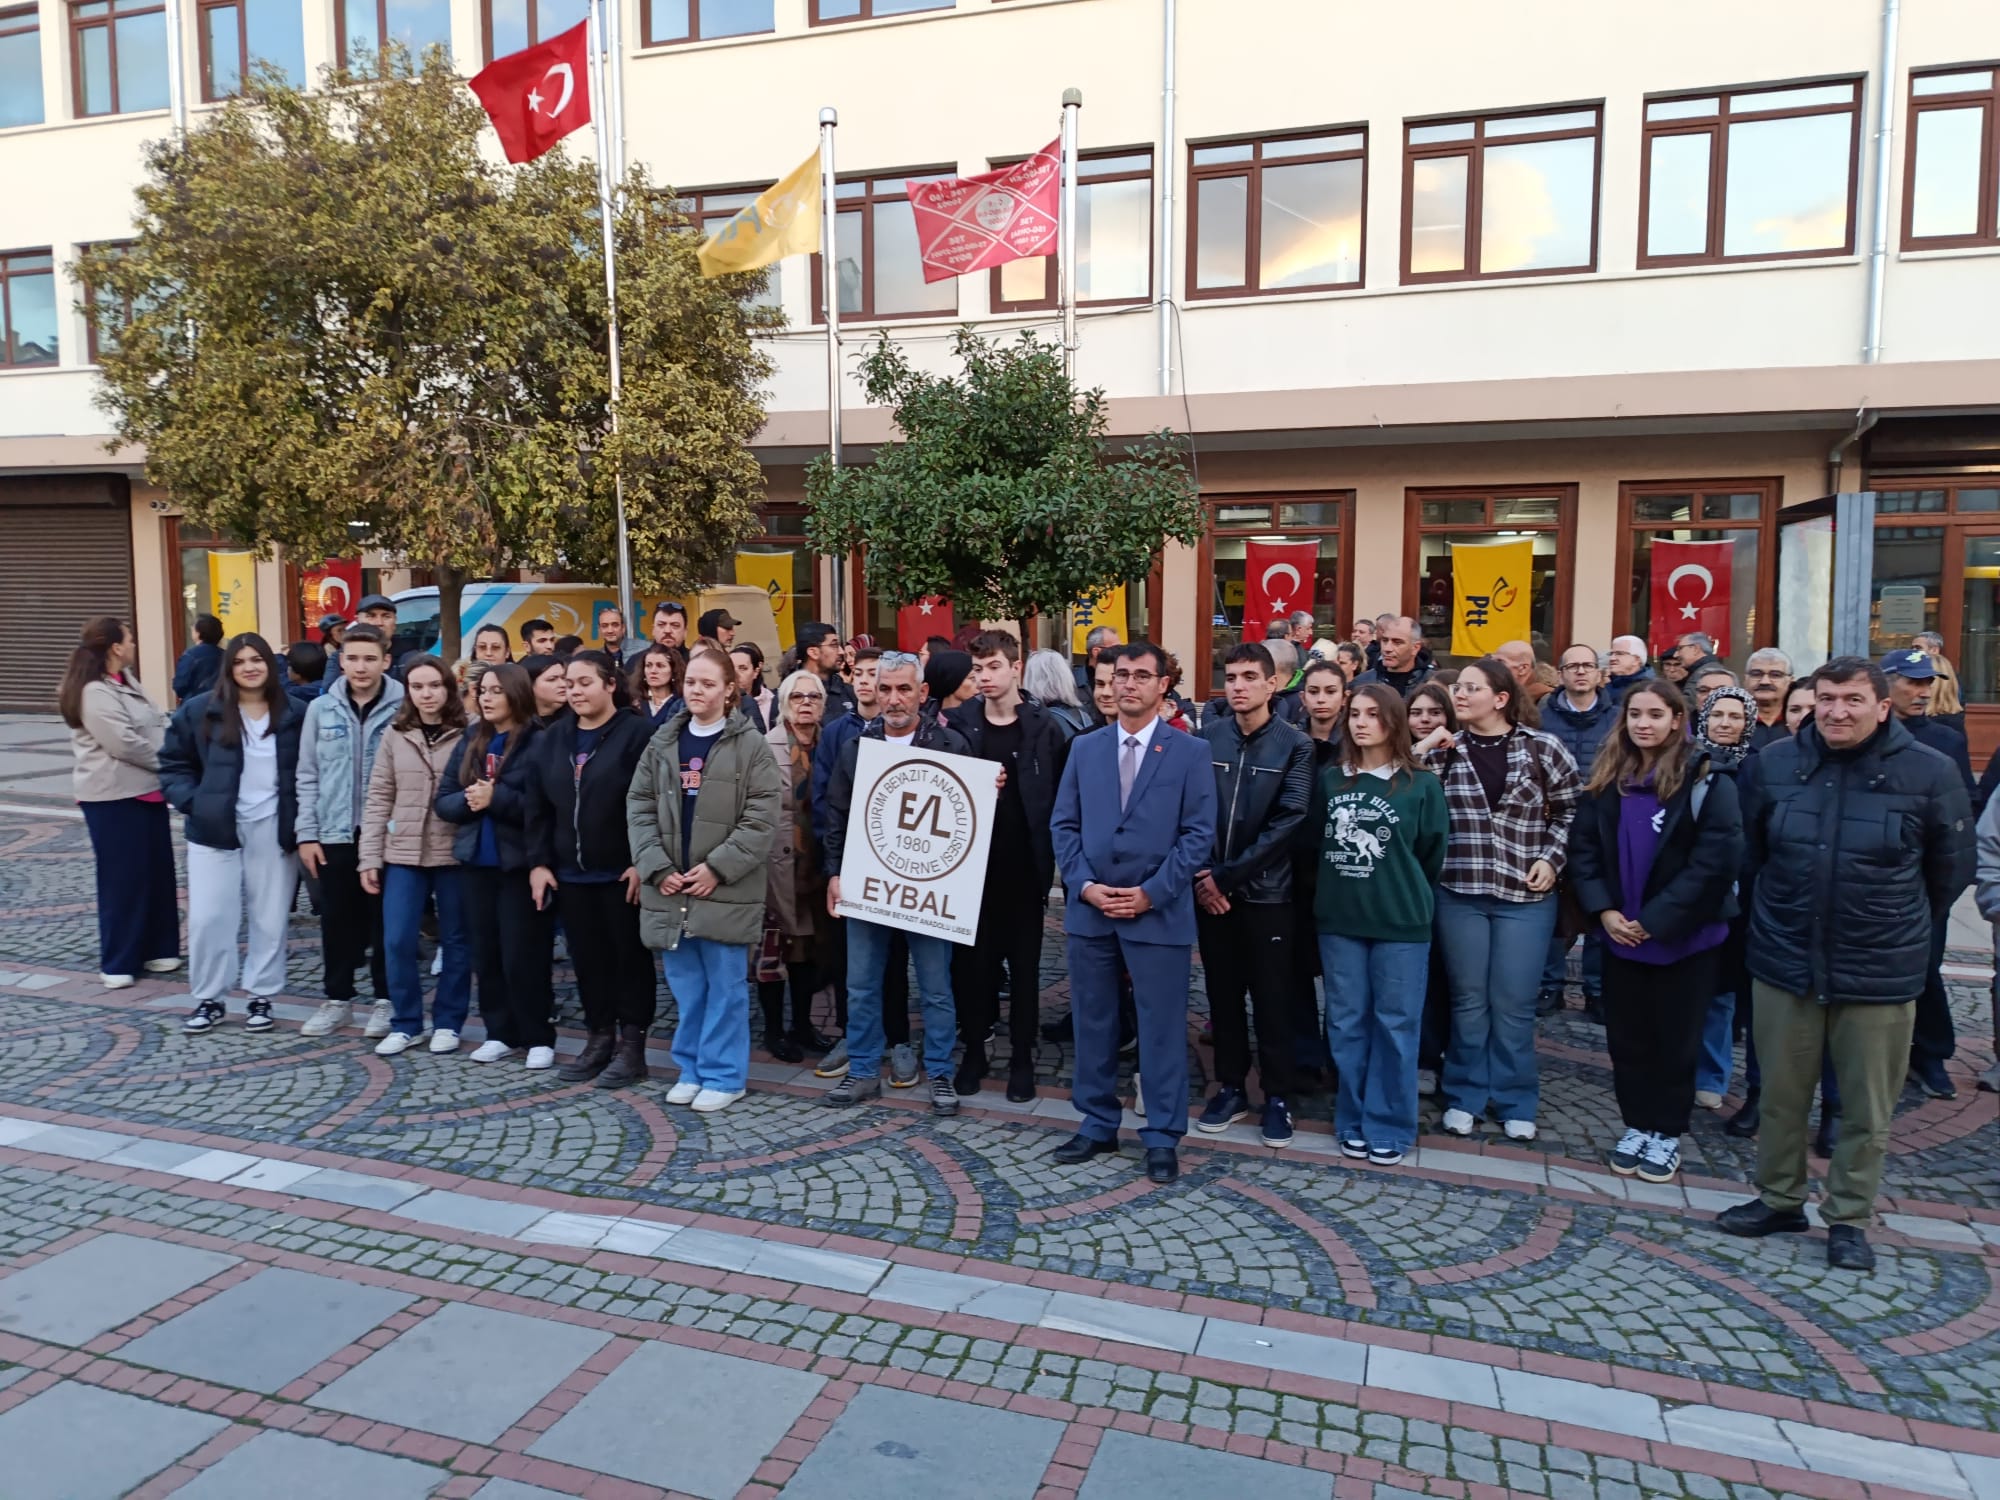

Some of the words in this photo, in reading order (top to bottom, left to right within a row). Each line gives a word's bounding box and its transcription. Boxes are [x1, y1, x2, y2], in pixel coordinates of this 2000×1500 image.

[591, 600, 647, 640] Pt
[1466, 595, 1490, 627] Ptt
[871, 792, 888, 852] YILDIRIM
[883, 769, 929, 793] BEYAZIT
[929, 774, 967, 826] ANADOLU
[1369, 795, 1400, 824] HILLS
[896, 834, 931, 854] 1980
[886, 850, 941, 875] EDİRNE
[863, 876, 956, 920] EYBAL
